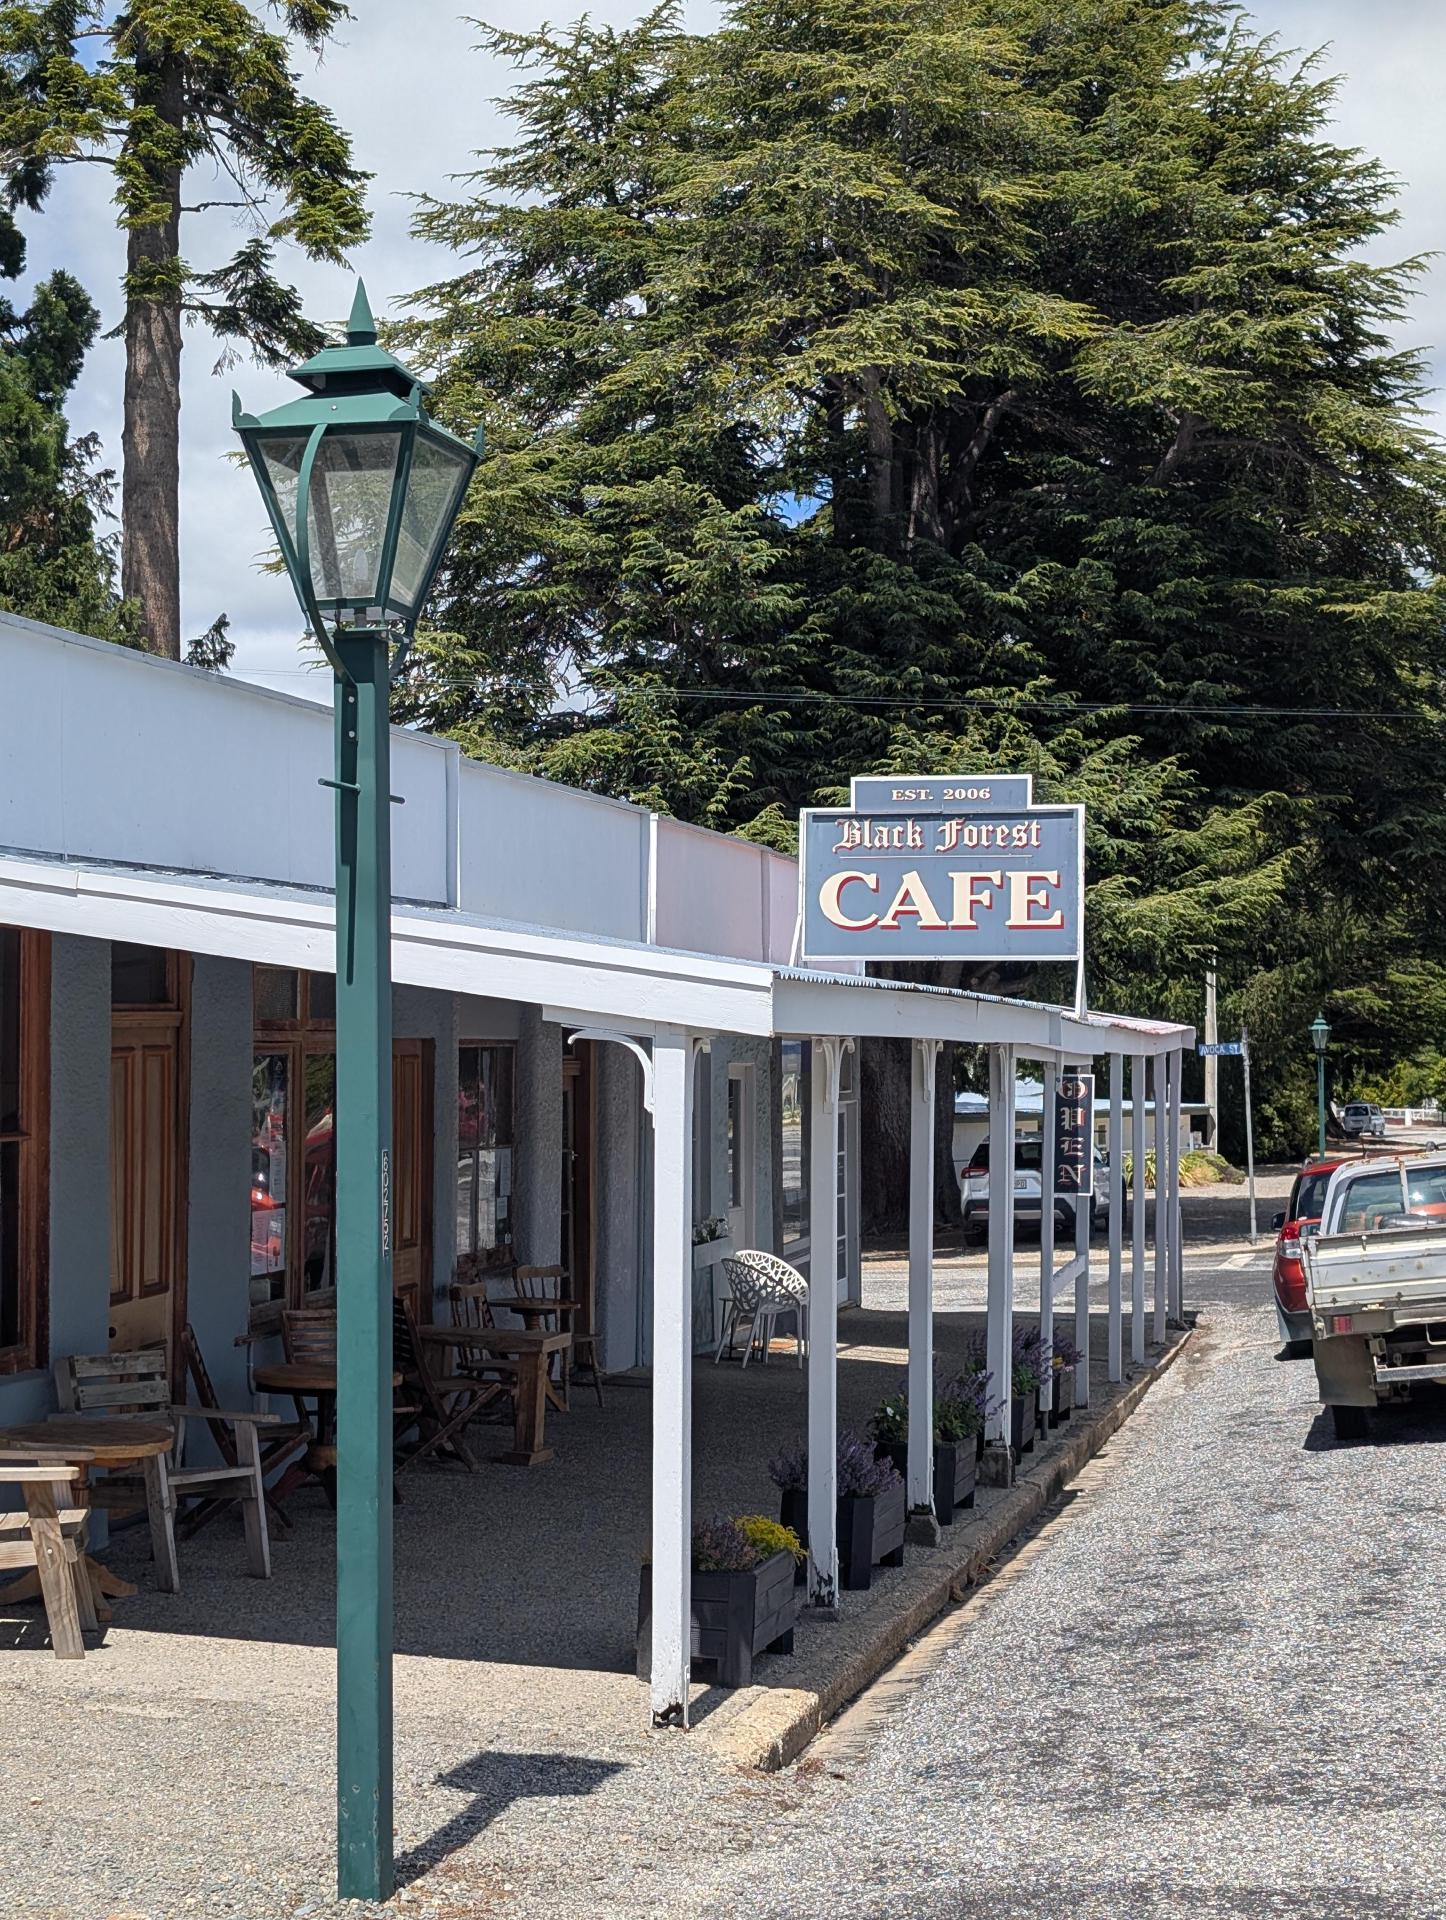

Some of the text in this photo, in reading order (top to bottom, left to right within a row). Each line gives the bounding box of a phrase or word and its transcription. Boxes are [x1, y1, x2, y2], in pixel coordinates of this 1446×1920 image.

[891, 786, 991, 801] EST. 2006
[832, 817, 1041, 853] Black Forest
[818, 870, 1065, 931] CAFE
[1200, 1044, 1239, 1056] AVOCA ST
[1058, 1080, 1088, 1187] OPEN
